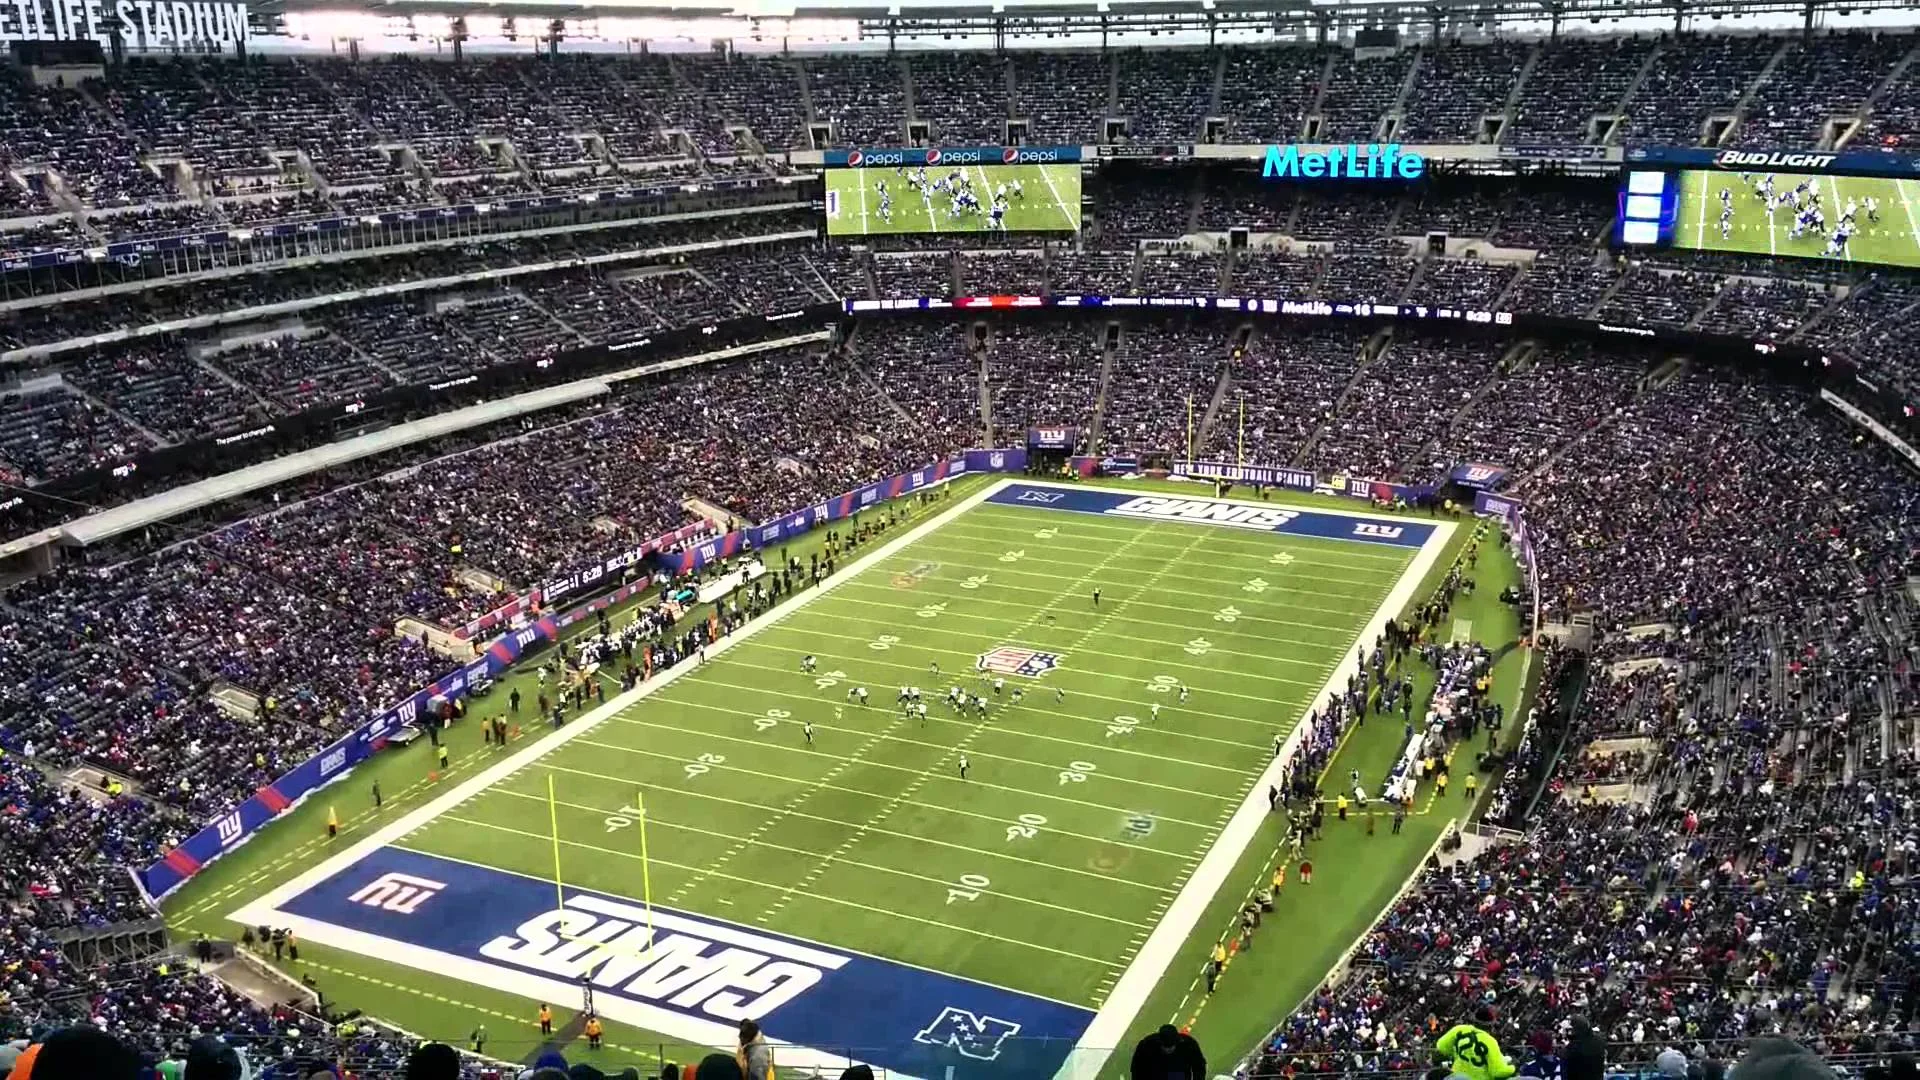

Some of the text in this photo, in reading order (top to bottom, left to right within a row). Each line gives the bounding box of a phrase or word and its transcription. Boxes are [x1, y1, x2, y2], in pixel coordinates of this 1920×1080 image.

[116, 0, 250, 43] STADIUM
[865, 152, 903, 167] pepsi
[942, 150, 981, 165] pepsi
[1020, 149, 1058, 164] pepsi
[1263, 144, 1425, 178] MetLife
[1720, 150, 1836, 168] BUD LIGHT
[1281, 301, 1333, 315] MetLife
[1198, 464, 1223, 478] YORK
[1227, 466, 1273, 482] FOTBALL
[1276, 472, 1312, 487] GIANTS
[1351, 480, 1370, 497] ny
[1115, 496, 1301, 527] GIANTS
[1354, 523, 1405, 538] ny
[1146, 675, 1179, 693] 50
[397, 700, 417, 726] ny
[1108, 715, 1140, 735] 40
[684, 753, 725, 775] 20
[1060, 761, 1096, 783] 30
[217, 810, 242, 846] ny
[1007, 813, 1048, 839] 20
[348, 872, 448, 914] ny
[949, 874, 991, 902] 10
[479, 909, 823, 1022] GIANTS
